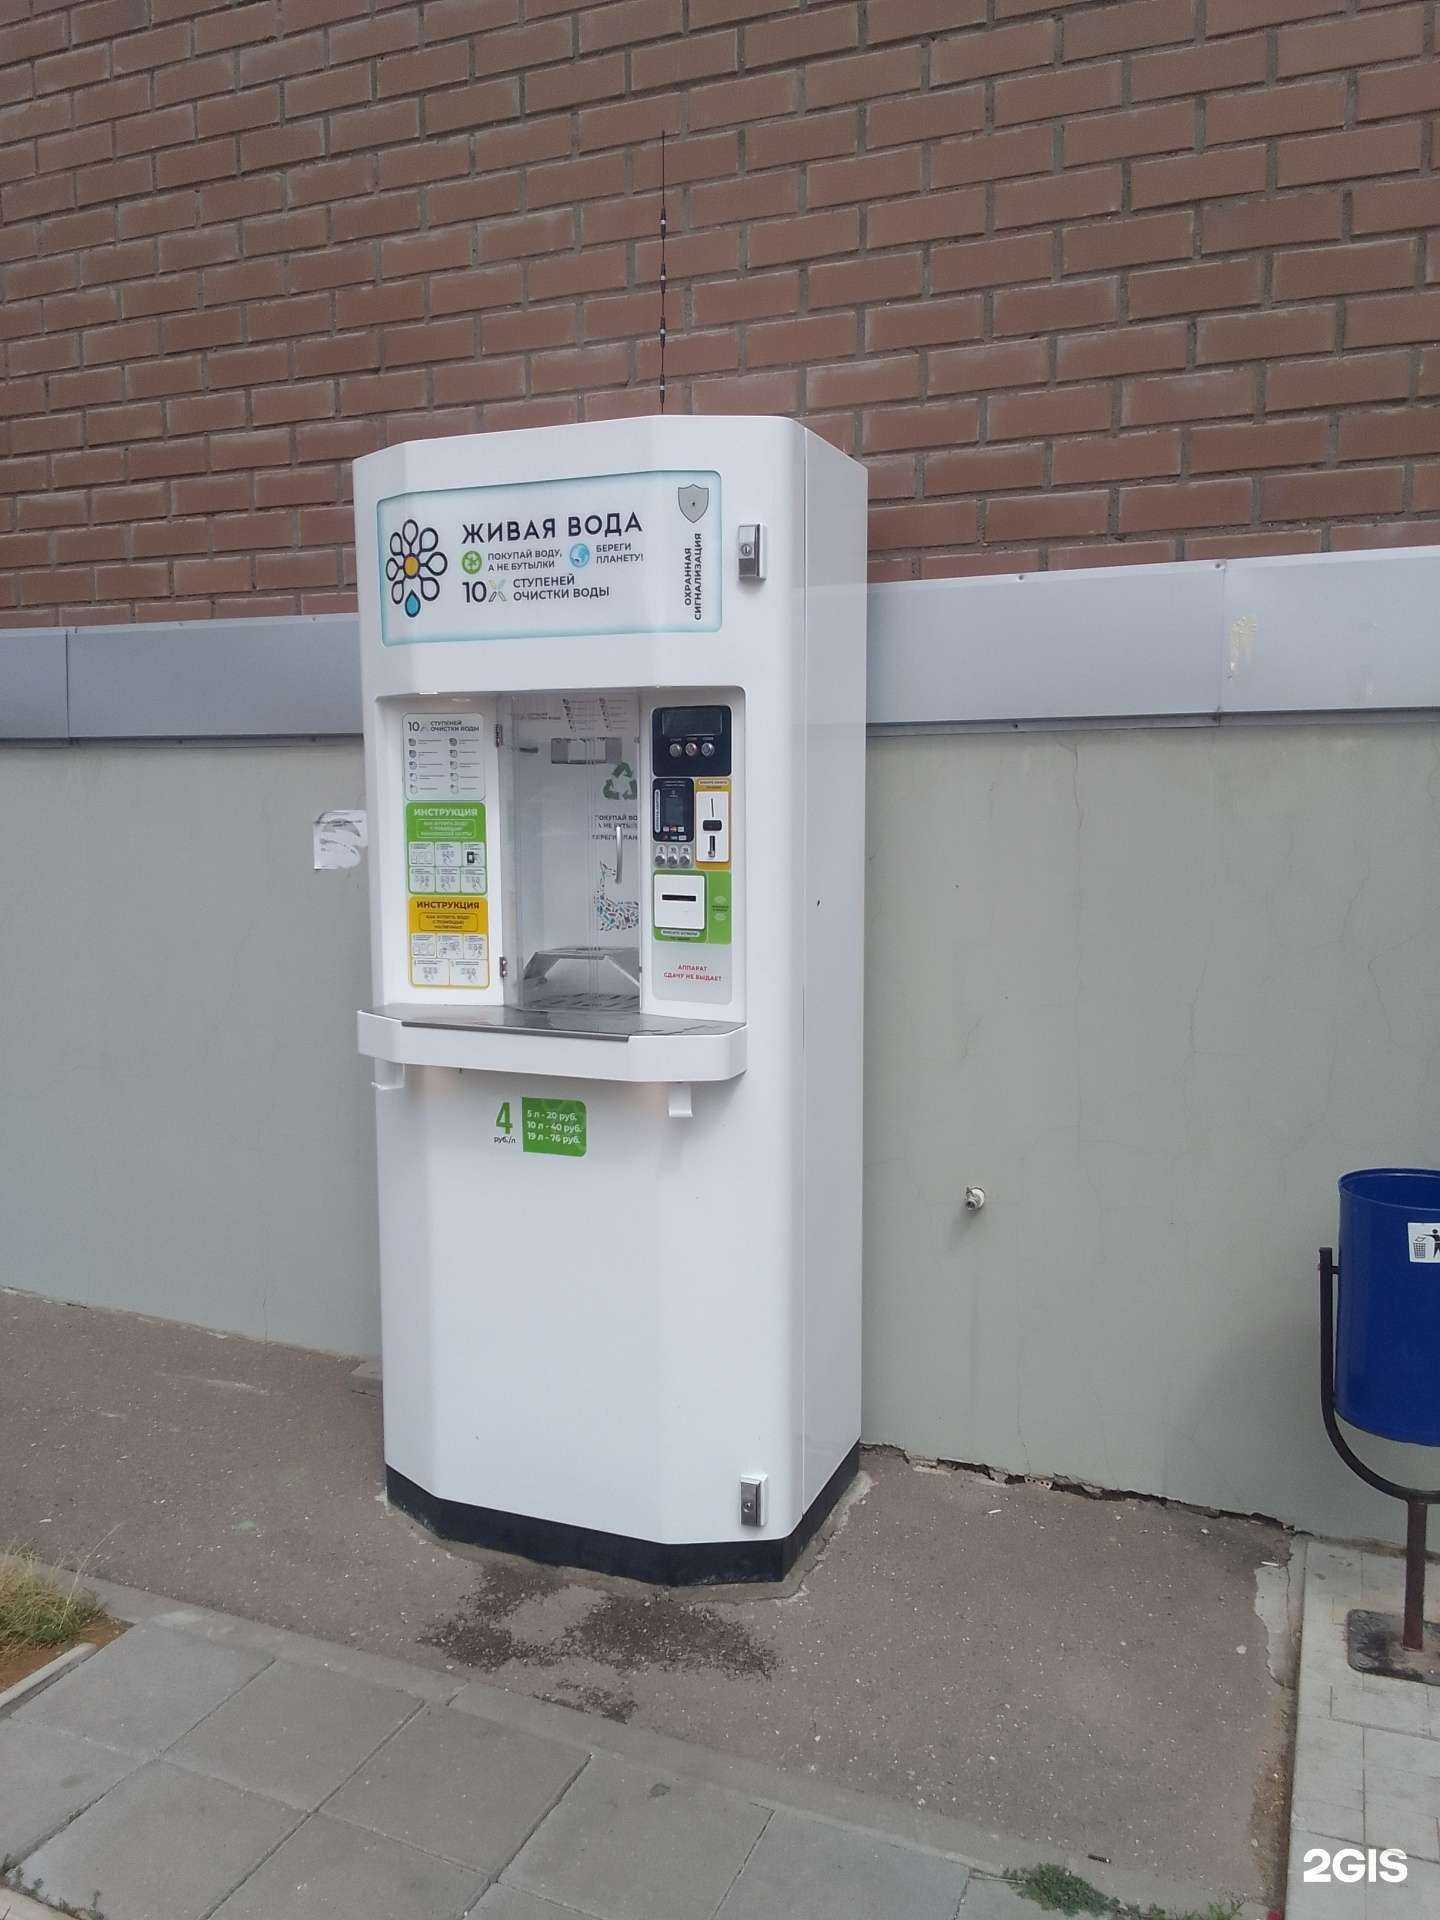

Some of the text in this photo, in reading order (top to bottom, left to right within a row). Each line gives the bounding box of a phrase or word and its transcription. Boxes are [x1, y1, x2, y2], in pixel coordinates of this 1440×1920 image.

[461, 511, 643, 544] ЖИВАЯ ВОДА
[595, 542, 632, 553] БЕРЕГИ
[487, 549, 563, 561] ПОКУПАЙ ВОДУ,
[595, 553, 644, 564] ПЛАНЕТУ!
[487, 560, 555, 572] А НЕ БУТЫЛКИ
[512, 573, 575, 588] СТУПЕНЕЙ
[684, 547, 692, 606] ОХРАННАЯ
[694, 533, 702, 621] СИГНАЛИЗАЦИЯ
[512, 586, 610, 601] ОЧИСТКИ ВОДЫ
[414, 808, 478, 817] ИНСТРУКЦИЯ
[416, 901, 480, 910] ИНСТРУКЦИЯ
[678, 964, 708, 972] АППАРАТ
[496, 1102, 513, 1135] 4
[527, 1110, 532, 1118] 5
[546, 1111, 558, 1119] 20
[559, 1113, 577, 1121] руб.
[527, 1121, 537, 1129] 10
[550, 1123, 562, 1131] 40
[563, 1124, 582, 1133] руб.
[537, 1133, 544, 1141] л
[562, 1135, 581, 1144] руб.
